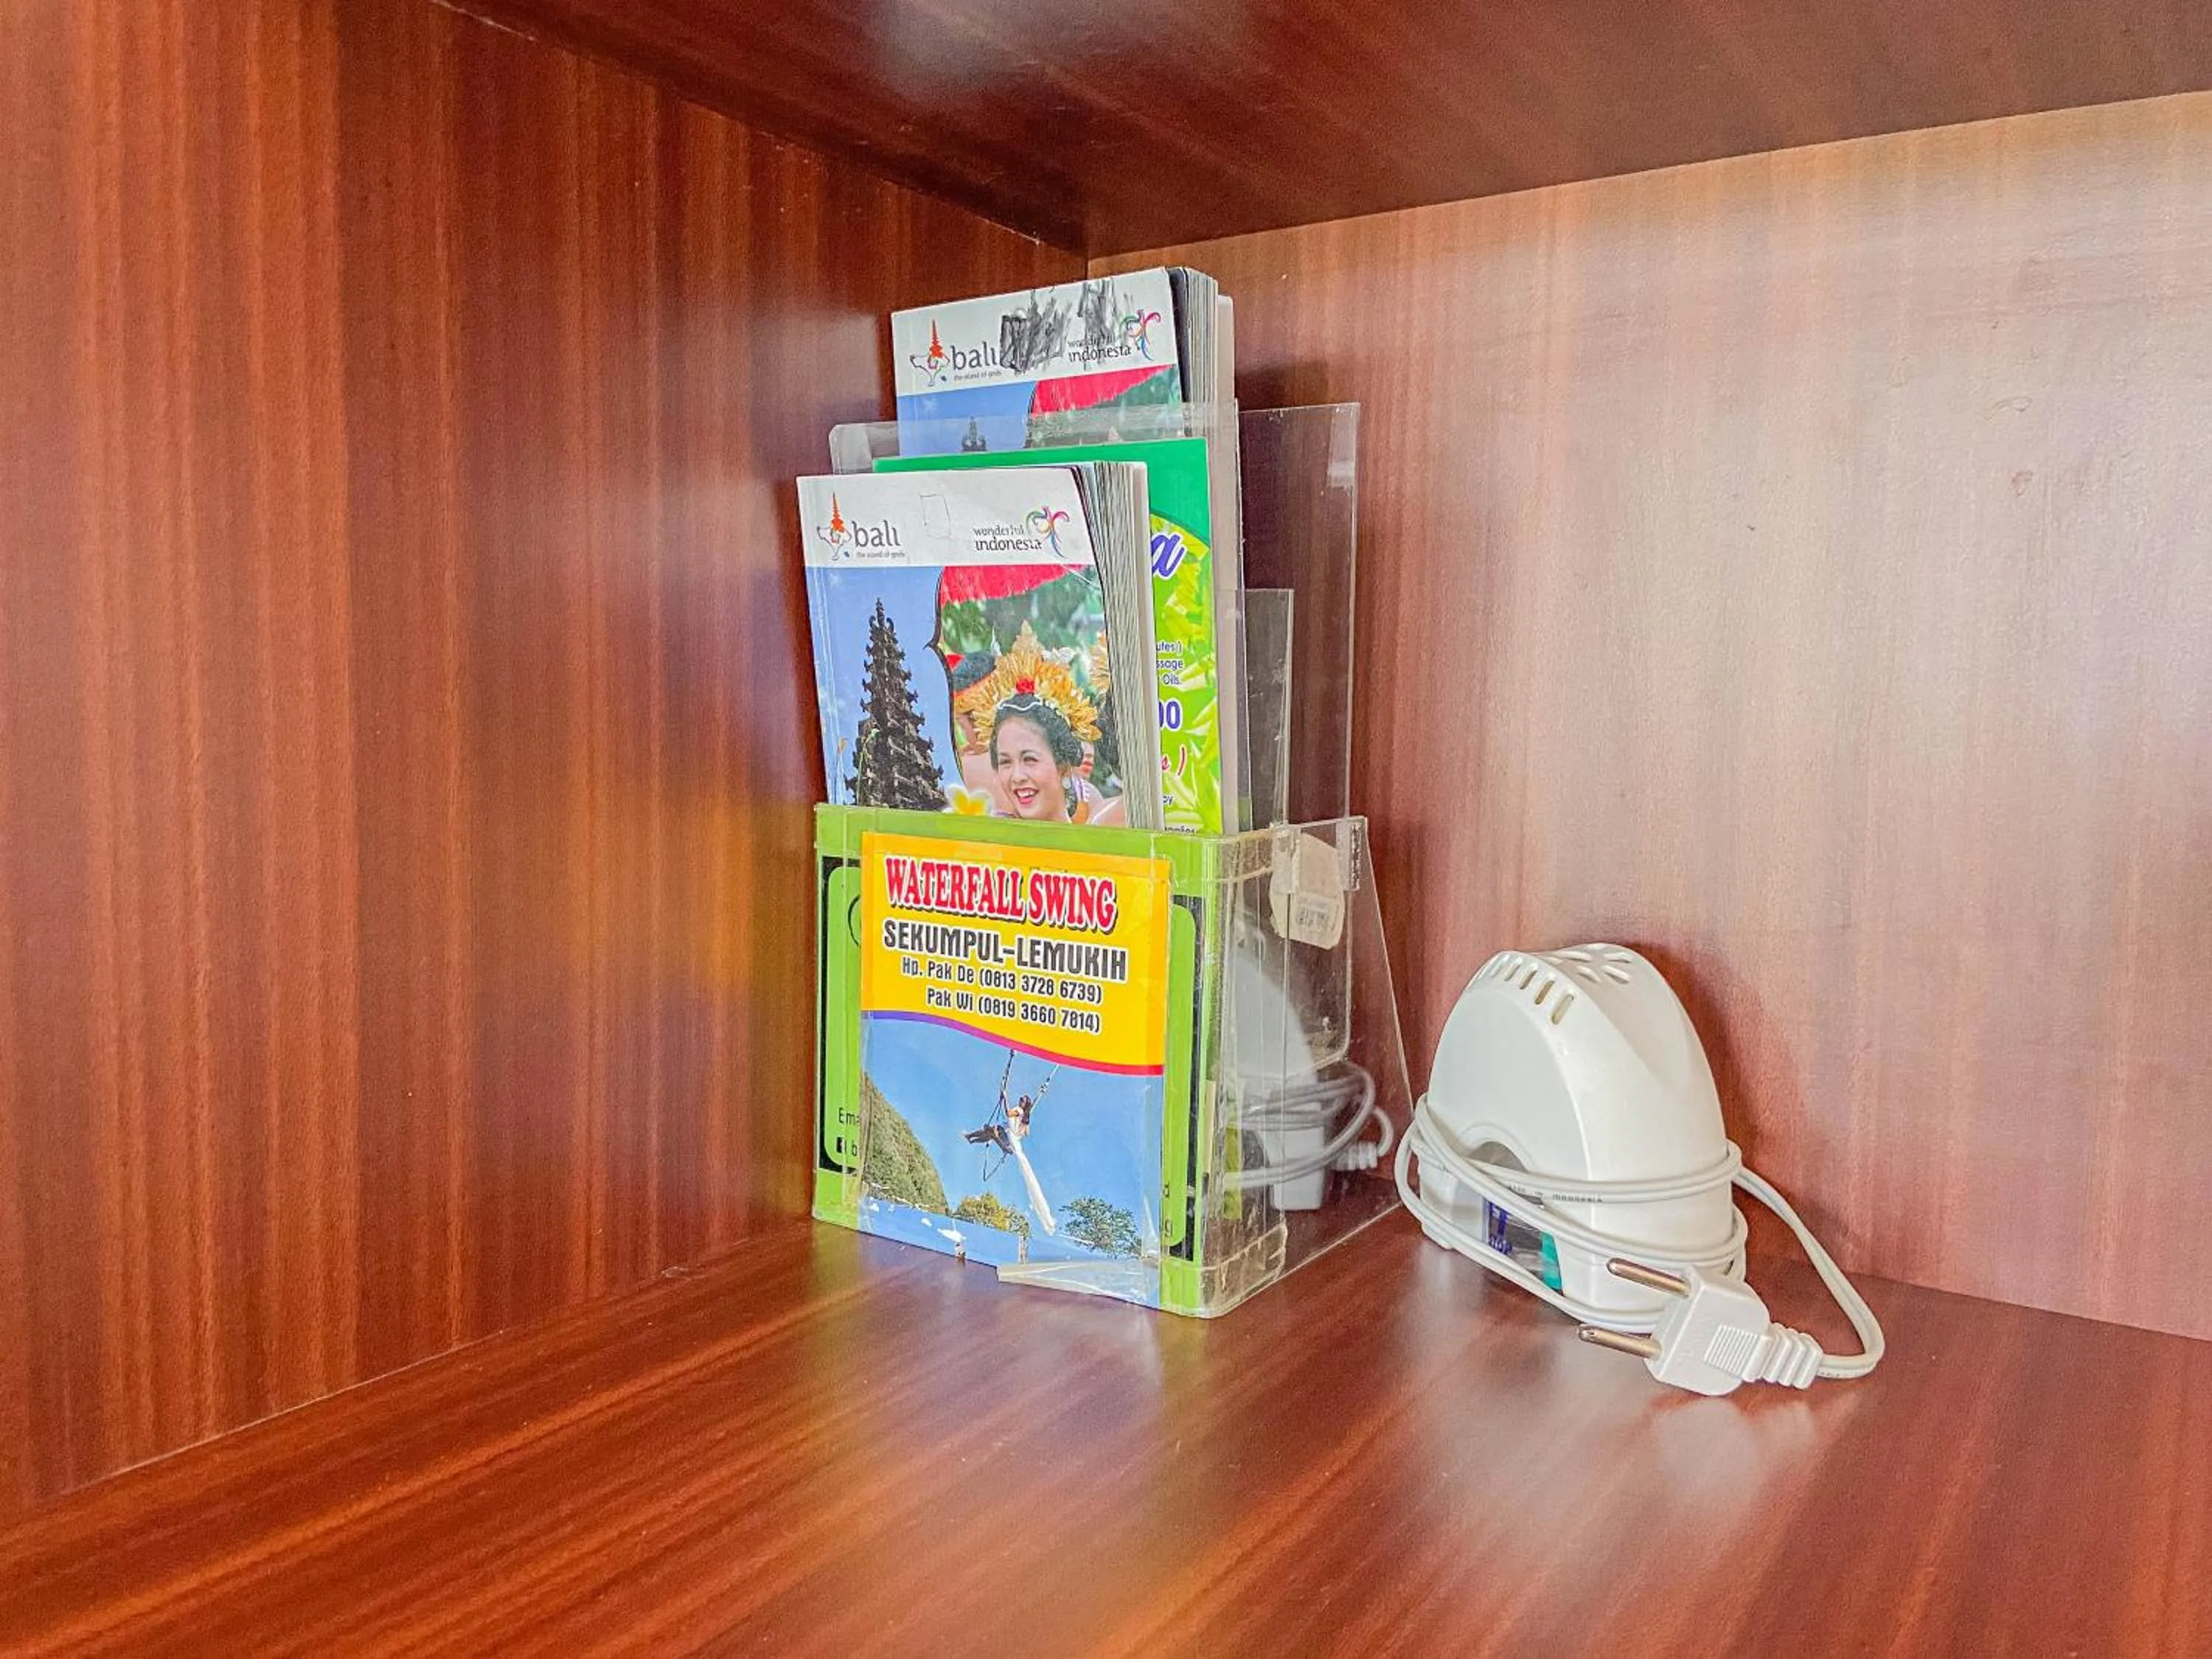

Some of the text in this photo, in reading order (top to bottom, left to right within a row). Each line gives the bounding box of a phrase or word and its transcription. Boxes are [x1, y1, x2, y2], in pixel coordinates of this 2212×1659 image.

[950, 341, 998, 370] bali
[1068, 344, 1132, 363] indonesia
[851, 519, 901, 548] bali
[973, 524, 1024, 538] wonderful
[975, 536, 1043, 552] indonesia
[885, 857, 1117, 934] WATERFALL SWING
[928, 960, 953, 981] Pak
[958, 964, 975, 984] De
[979, 967, 1016, 990] (0813
[1021, 974, 1054, 996] 3728
[1060, 979, 1102, 1004] 6739)
[927, 987, 1100, 1033] Pak Wi (0819 3660 7814)
